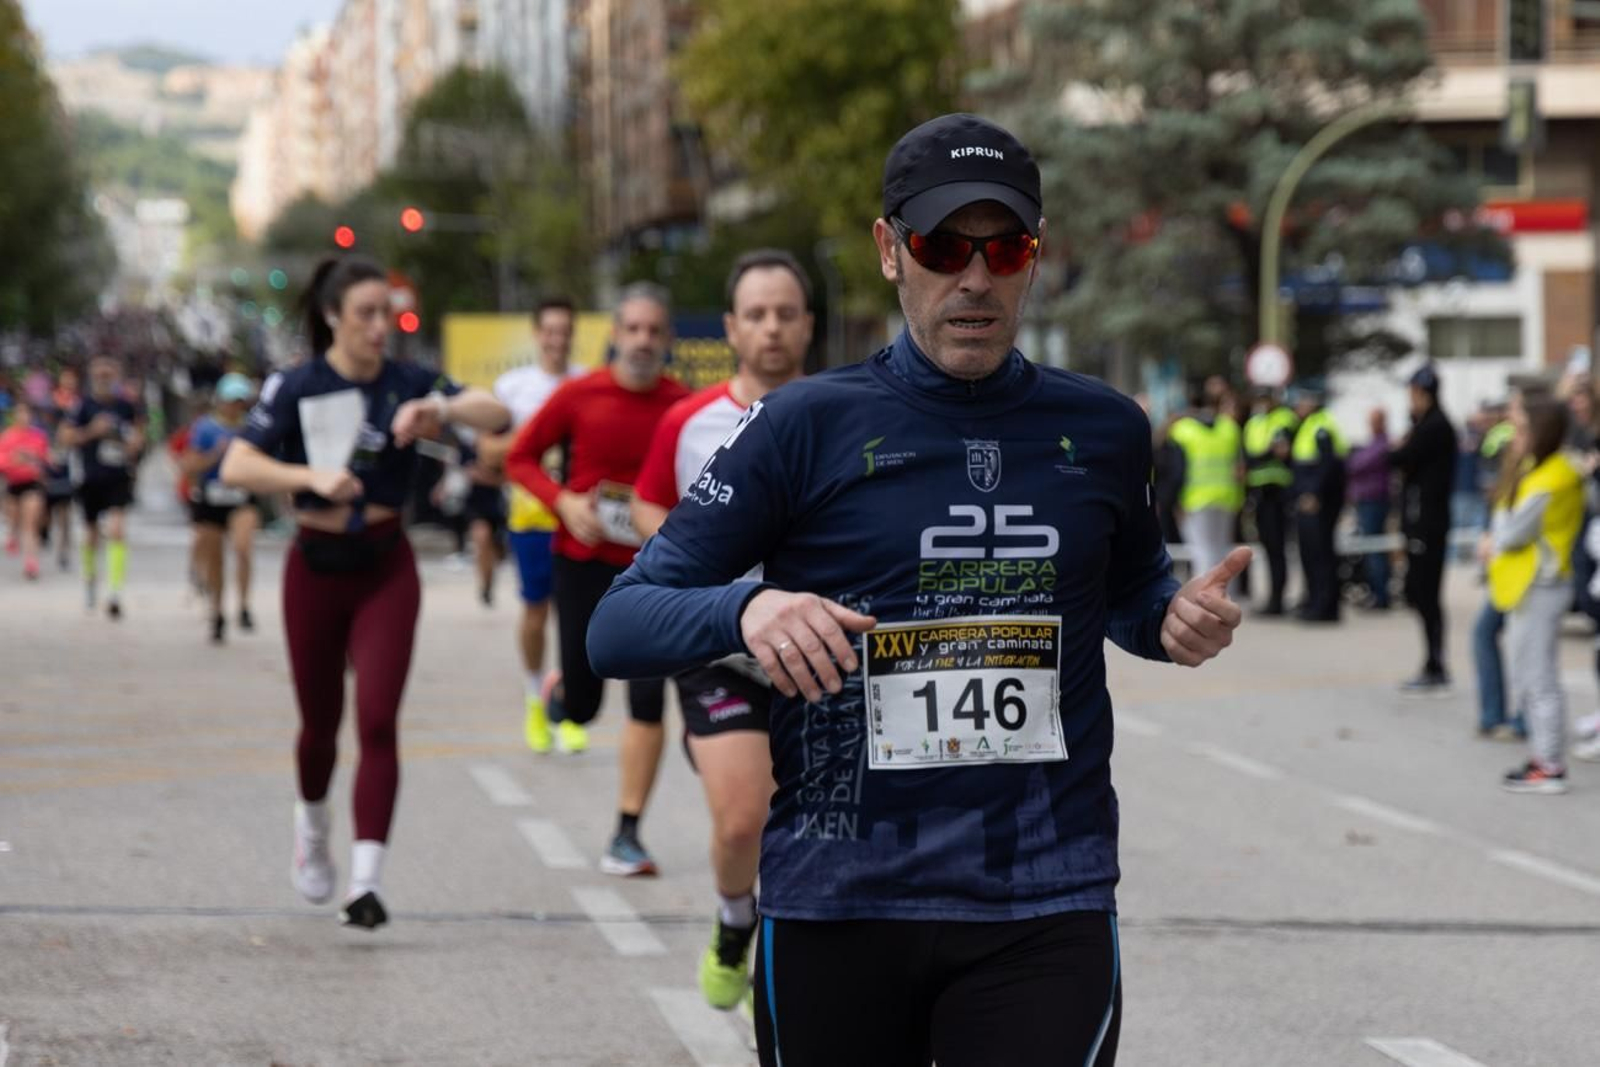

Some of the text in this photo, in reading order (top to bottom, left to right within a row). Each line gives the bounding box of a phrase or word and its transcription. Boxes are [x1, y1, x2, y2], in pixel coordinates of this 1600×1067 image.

[950, 146, 1004, 161] KIPRUN
[919, 504, 1061, 560] 25
[919, 560, 1058, 577] CARRERA
[918, 576, 1057, 594] POPULAR
[916, 594, 929, 606] y
[934, 594, 975, 606] gran
[919, 626, 1053, 643] CARRERA POPULAR
[873, 631, 917, 660] XXV
[919, 637, 1053, 656] y gran caminata
[917, 659, 934, 671] LA
[965, 656, 982, 668] LA
[912, 676, 1028, 733] 146
[829, 768, 854, 804] DE
